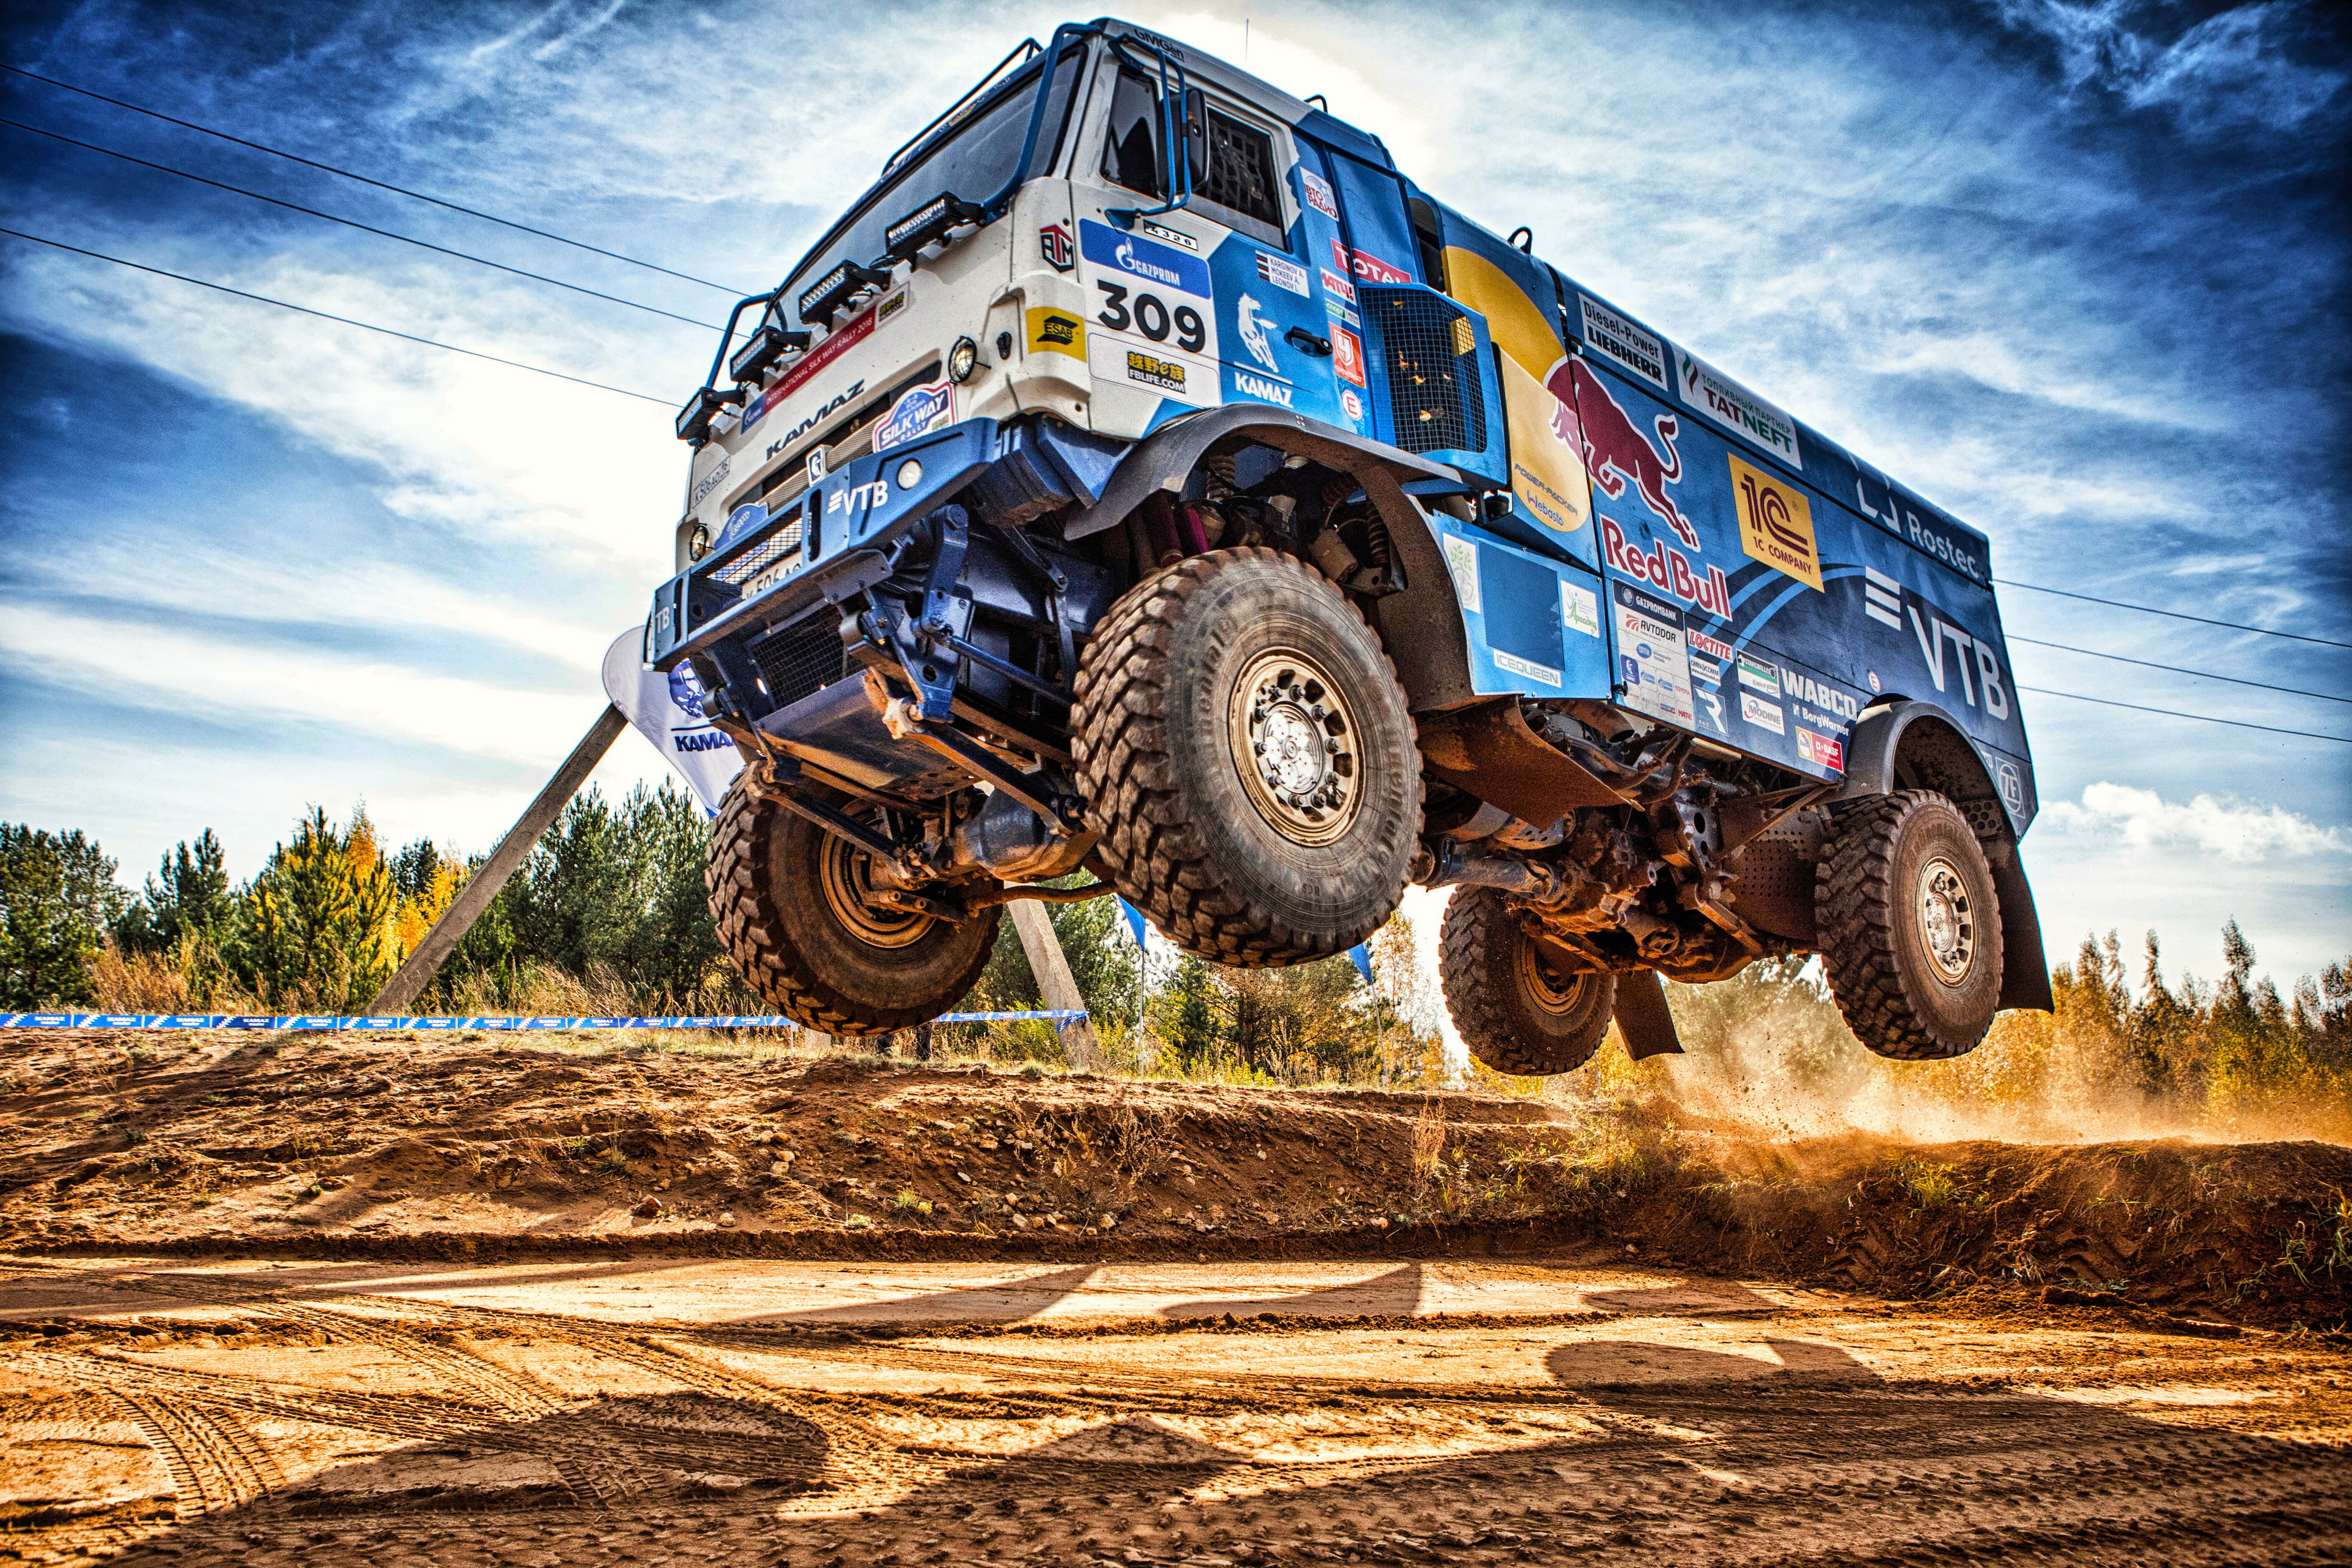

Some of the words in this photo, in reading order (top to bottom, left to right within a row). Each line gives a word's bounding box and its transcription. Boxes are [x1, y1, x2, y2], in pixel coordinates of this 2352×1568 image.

[1136, 260, 1181, 287] GAZPROM
[1270, 258, 1297, 275] KARGINOV
[1271, 266, 1293, 281] MOKEEV
[1272, 275, 1294, 290] LEONOV
[1045, 323, 1073, 339] ESAB
[1097, 279, 1206, 353] 309
[1584, 301, 1659, 358] Diesel-Power
[809, 356, 822, 371] SILK
[822, 343, 836, 360] WAY
[837, 329, 856, 349] RALLY
[1588, 325, 1662, 383] LIEBHERR
[1129, 369, 1185, 392] FBLIFE.COM
[1235, 372, 1293, 408] KAMAZ
[1701, 374, 1754, 412] ТОПЛИВНЫЙ
[1755, 407, 1790, 433] ПАРТНЕР
[767, 378, 864, 461] KAMAZ
[881, 413, 914, 446] SILK
[914, 393, 945, 423] WAY
[900, 421, 926, 441] RALLY
[1703, 386, 1792, 453] TATNEFT
[843, 480, 888, 516] VTB
[1514, 463, 1578, 516] POWER-PACKER
[1527, 489, 1563, 526] Webasto
[1753, 536, 1764, 551] 1C
[1769, 544, 1811, 574] COMPANY
[1906, 510, 1979, 579] Rostec
[1599, 514, 1671, 594] Red
[1668, 547, 1732, 621] Bull
[1566, 602, 1597, 629] Ариадна
[1636, 596, 1677, 621] GAZPROMBANK
[1641, 621, 1676, 643] AVTODOR
[1689, 631, 1731, 660] LOCTITE
[1497, 654, 1558, 684] ICEQUEEN
[1744, 658, 1770, 674] STAHLWILLE
[1907, 605, 2009, 721] VTB
[1675, 685, 1690, 695] TOYOTA
[1753, 679, 1763, 688] Ключ
[1781, 667, 1857, 721] WABCO
[1748, 705, 1781, 724] MODINE
[1802, 707, 1849, 736] BorgWarner
[675, 731, 735, 752] KAMA
